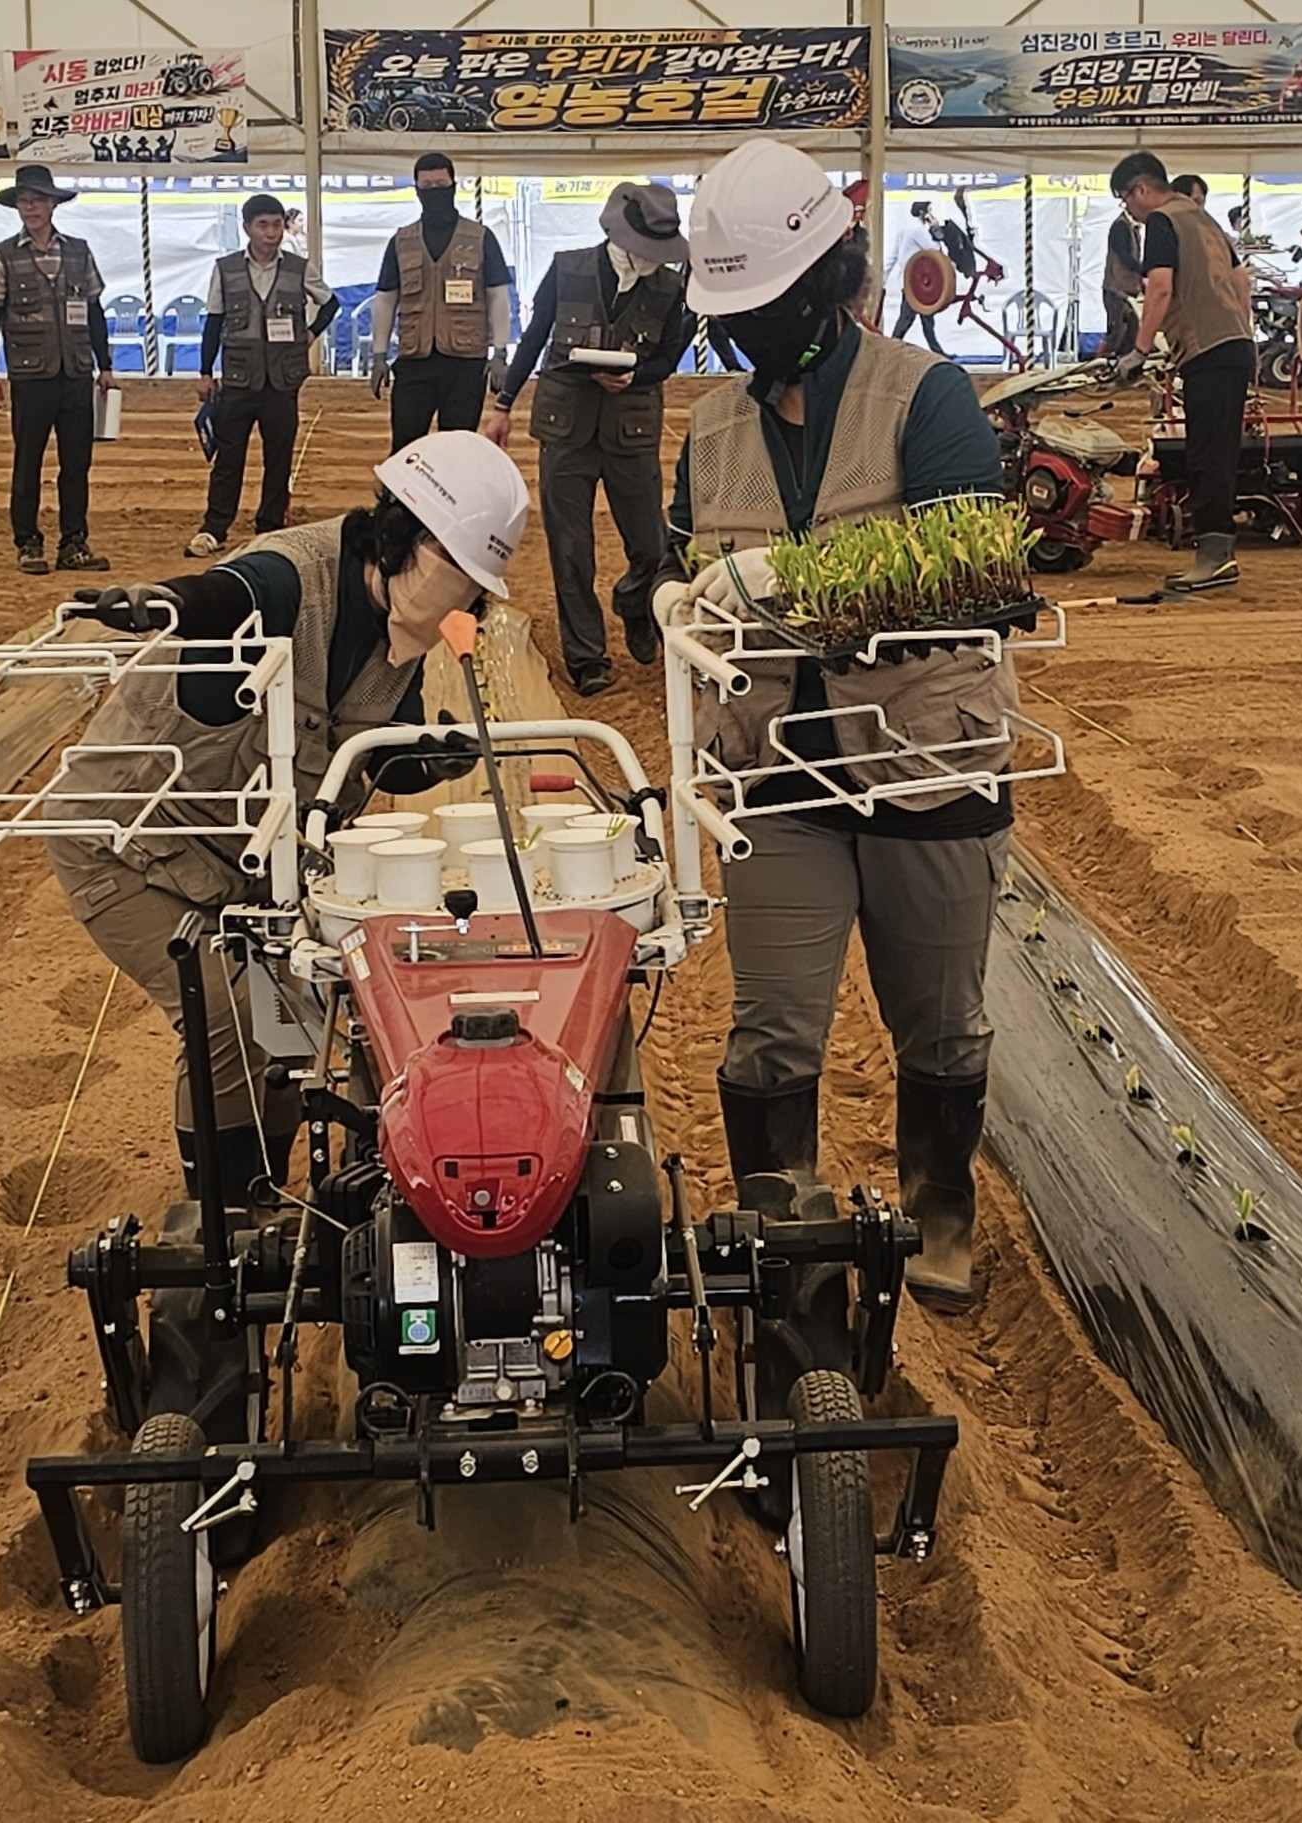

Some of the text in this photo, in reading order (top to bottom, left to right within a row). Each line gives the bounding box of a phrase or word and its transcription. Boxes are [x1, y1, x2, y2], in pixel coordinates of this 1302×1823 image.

[1021, 30, 1272, 53] 섬진강이 흐르고, 우리는 달린다.
[42, 54, 146, 84] 시동 걸었다!
[373, 36, 863, 80] 오늘 판은 우리가 갈아엎는다!
[1049, 56, 1202, 87] 섬진강 모터스
[74, 80, 163, 104] 멈추지 마라!
[493, 76, 776, 126] 영농호걸
[1054, 84, 1143, 109] 우승까지
[31, 109, 132, 139] 진주악바리
